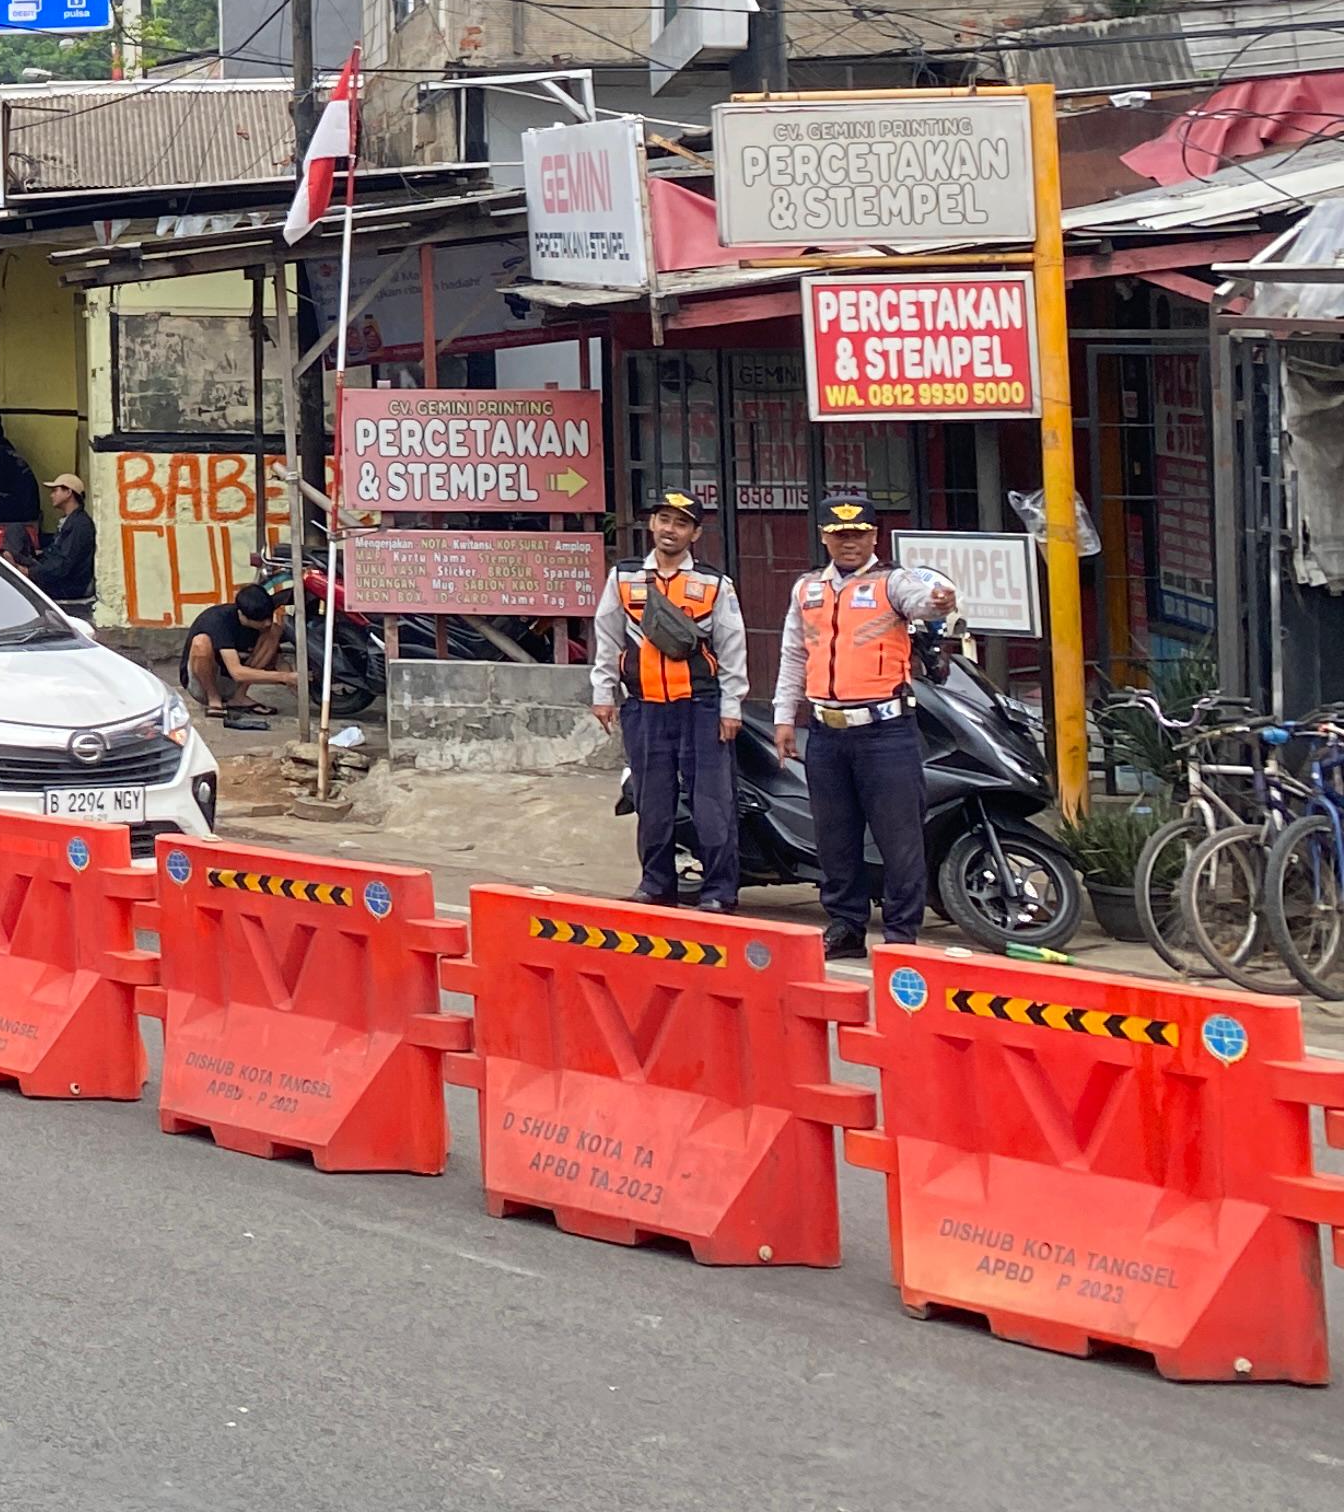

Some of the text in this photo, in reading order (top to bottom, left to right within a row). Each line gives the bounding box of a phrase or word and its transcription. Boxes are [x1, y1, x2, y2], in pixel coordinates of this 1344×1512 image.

[64, 10, 91, 19] pulsa
[807, 120, 875, 141] GEMINI
[879, 117, 973, 139] PRINTING
[741, 138, 1010, 187] PERCETAKAN
[541, 149, 613, 214] GEMINI
[768, 182, 989, 230] & STEMPEL
[817, 286, 1023, 333] PERCETAKAN
[835, 335, 1013, 381] & STEMPEL
[417, 400, 473, 416] GEMINI
[478, 399, 554, 417] PRINTING
[824, 381, 1025, 407] WA. 0812 9930 5000
[354, 418, 591, 458] PERCETAKAN
[357, 461, 540, 502] & STEMPEL
[355, 563, 385, 575] BUKU
[393, 551, 426, 562] Kartu
[355, 590, 389, 602] NEON
[501, 594, 536, 606] Name
[463, 579, 505, 591] SABLON
[511, 580, 540, 592] KAOS
[50, 790, 141, 813] B 2294 NGY
[185, 1051, 332, 1099] DISHUB KOTA TANGSEL
[206, 1079, 244, 1101] APBD
[255, 1090, 268, 1106] P
[269, 1095, 299, 1114] 2023
[576, 1129, 623, 1161] KOTA
[529, 1151, 581, 1181] APBD
[939, 1218, 1180, 1290] DISHUB KOTA TANGSEL
[975, 1255, 1126, 1305] APBD P 2023
